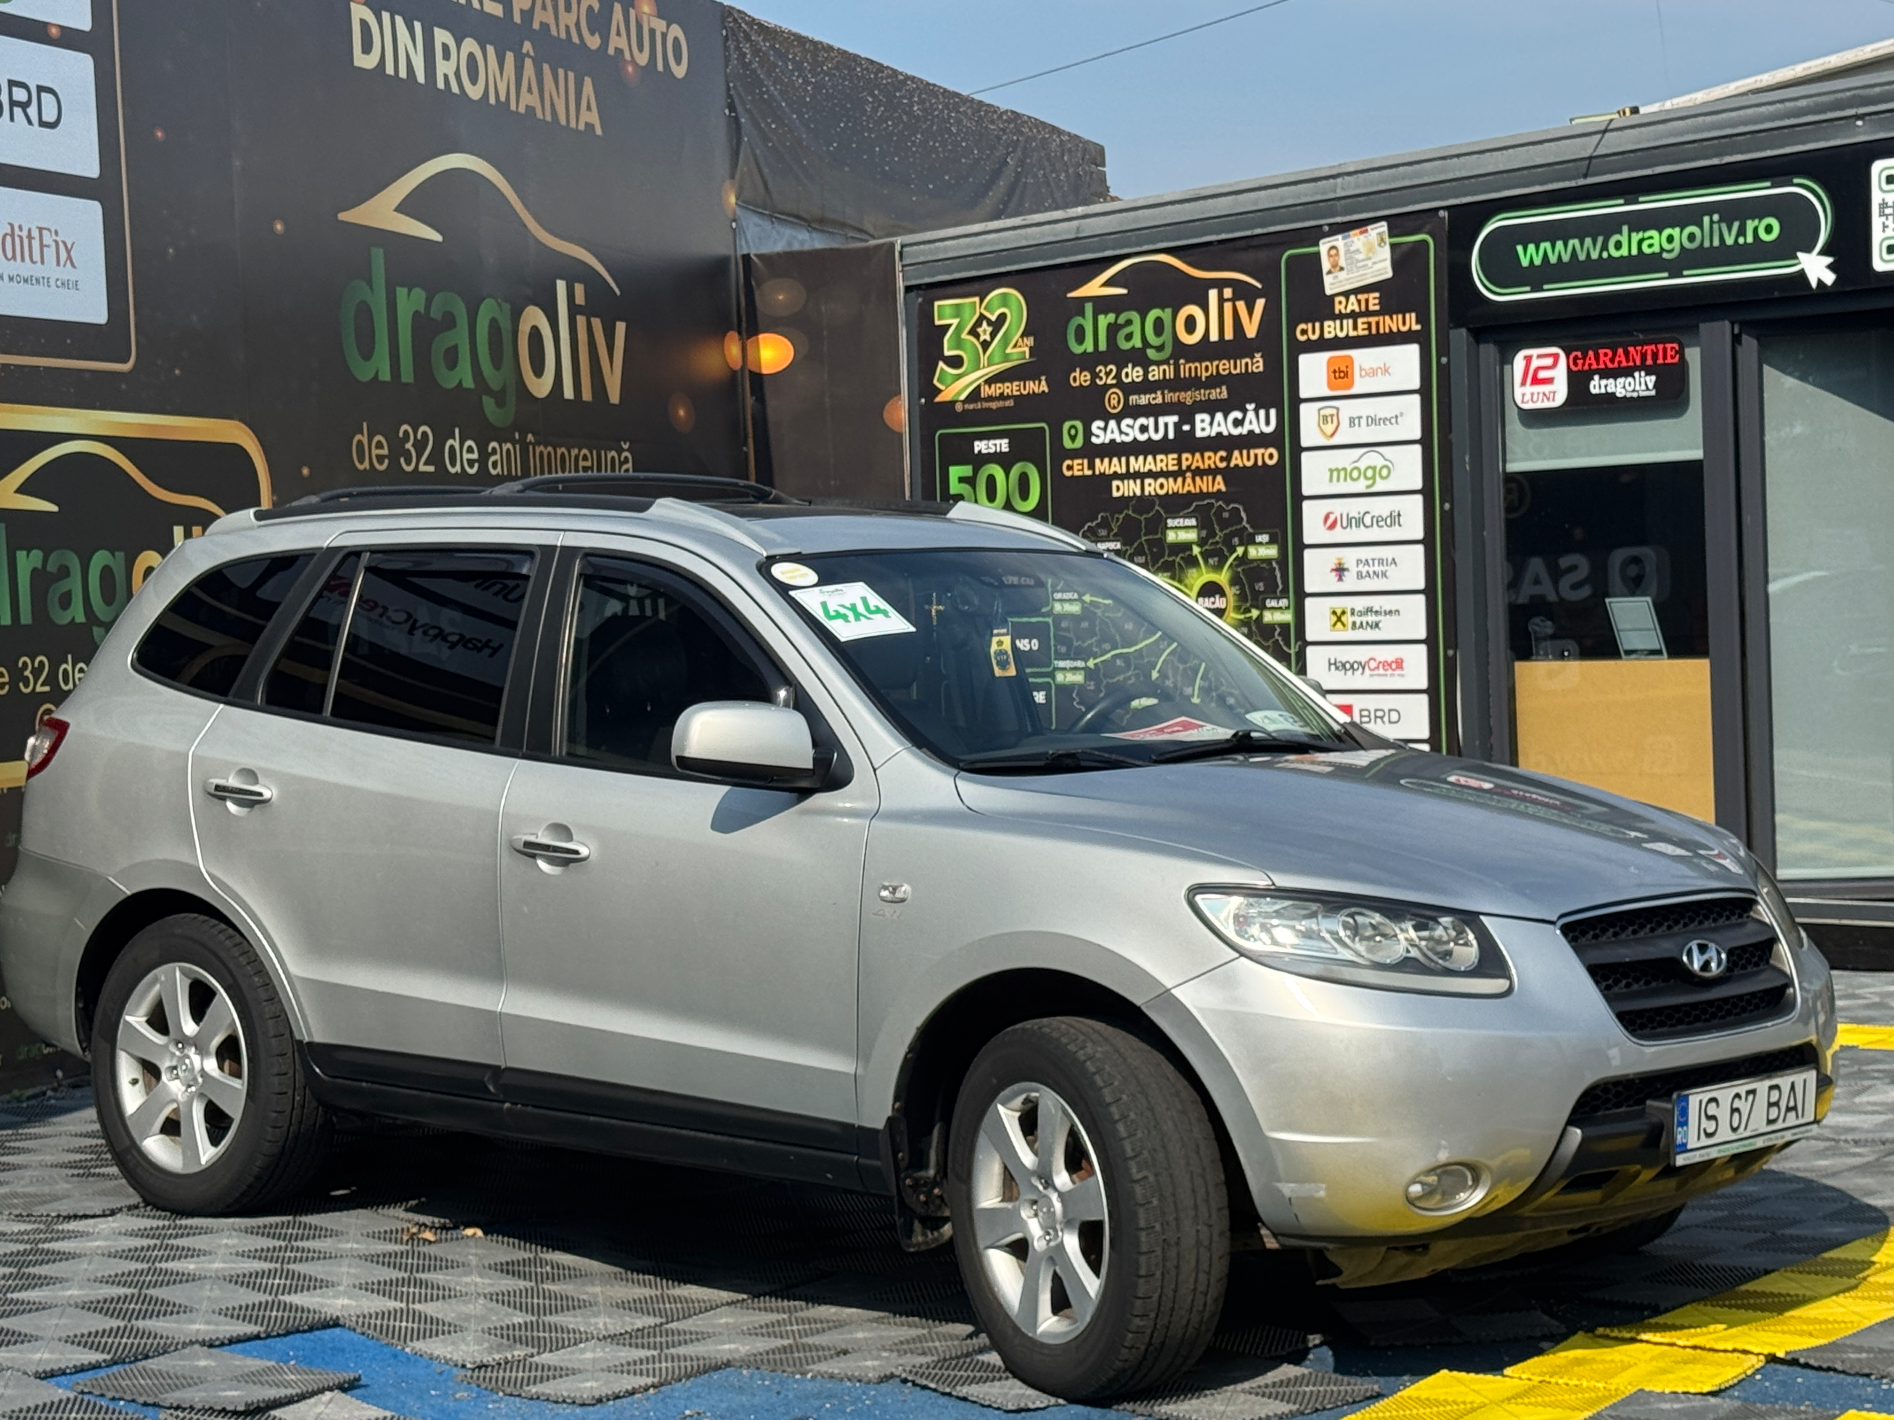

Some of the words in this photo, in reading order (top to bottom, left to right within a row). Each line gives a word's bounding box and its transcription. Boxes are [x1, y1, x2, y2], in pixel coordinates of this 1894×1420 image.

[607, 2, 689, 80] AUTO
[350, 2, 426, 85] DIN
[432, 26, 603, 136] ROMÂNIA
[0, 78, 63, 130] RD
[1516, 213, 1781, 268] www.dragoliv.ro
[8, 274, 51, 288] MOMENTE
[55, 279, 80, 291] CHEIE
[1334, 292, 1380, 315] RATE
[340, 246, 627, 428] dragoliv
[1066, 287, 1266, 361] dragoliv
[1295, 322, 1321, 342] CU
[1323, 312, 1422, 339] BULETINUL
[933, 287, 1028, 391] 32
[1069, 367, 1091, 387] de
[1095, 364, 1118, 385] 32
[1121, 362, 1144, 383] de
[1148, 360, 1175, 381] ani
[1179, 352, 1264, 381] împreună
[1519, 352, 1561, 388] 12
[1568, 342, 1680, 372] GARANTIE
[1331, 365, 1349, 380] tbi
[1358, 362, 1392, 379] bank
[1589, 370, 1657, 398] dragoliv
[1129, 390, 1163, 406] marcă
[1521, 390, 1558, 405] LUNI
[1090, 415, 1179, 445] SASCUT
[1195, 404, 1277, 439] BACĂU
[1321, 413, 1335, 426] BT
[1348, 415, 1363, 429] BT
[352, 422, 389, 471] de
[399, 424, 436, 473] 32
[444, 427, 479, 474] de
[487, 432, 522, 476] ani
[973, 438, 1010, 455] PESTE
[1062, 458, 1093, 477] CEL
[1095, 455, 1127, 476] MAI
[1130, 452, 1179, 474] MARE
[1181, 450, 1228, 472] PARC
[1230, 447, 1279, 467] AUTO
[949, 461, 1041, 513] 500
[1112, 478, 1144, 498] DIN
[1146, 473, 1227, 496] ROMÂNIA
[1328, 464, 1392, 490] mogo
[1340, 509, 1403, 530] UniCredit
[1356, 557, 1398, 569] PATRIA
[1356, 569, 1389, 581] BANK
[1350, 605, 1401, 618] Raiffeisen
[1351, 619, 1382, 632] BANK
[18, 655, 51, 693] 32
[1327, 656, 1405, 677] HappyCredit
[1358, 708, 1402, 725] BRD
[1697, 1095, 1721, 1142] IS
[1728, 1088, 1758, 1135] 67
[1765, 1077, 1808, 1127] BAI
[1675, 1126, 1689, 1145] RO
